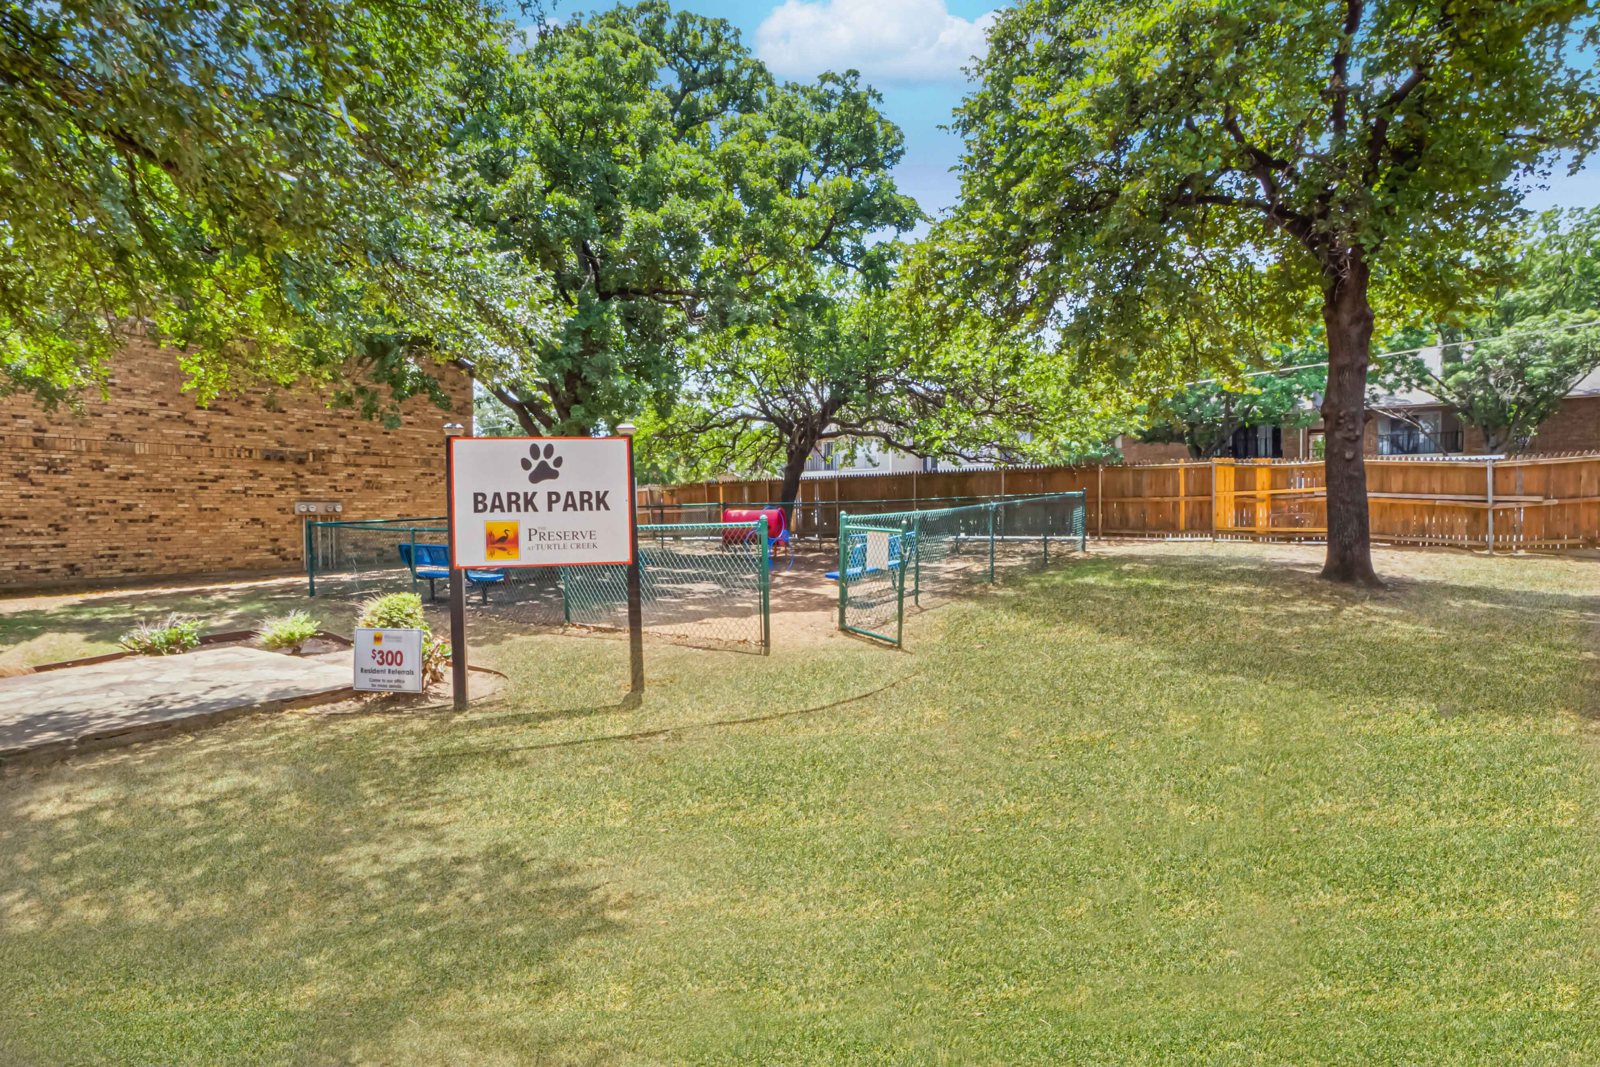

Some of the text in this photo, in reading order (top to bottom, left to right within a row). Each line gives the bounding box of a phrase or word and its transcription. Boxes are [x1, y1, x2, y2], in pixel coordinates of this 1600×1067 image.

[473, 490, 611, 513] BARK PARK
[528, 528, 597, 541] PRESERVE
[535, 543, 568, 551] TURTLE
[371, 648, 404, 667] $300
